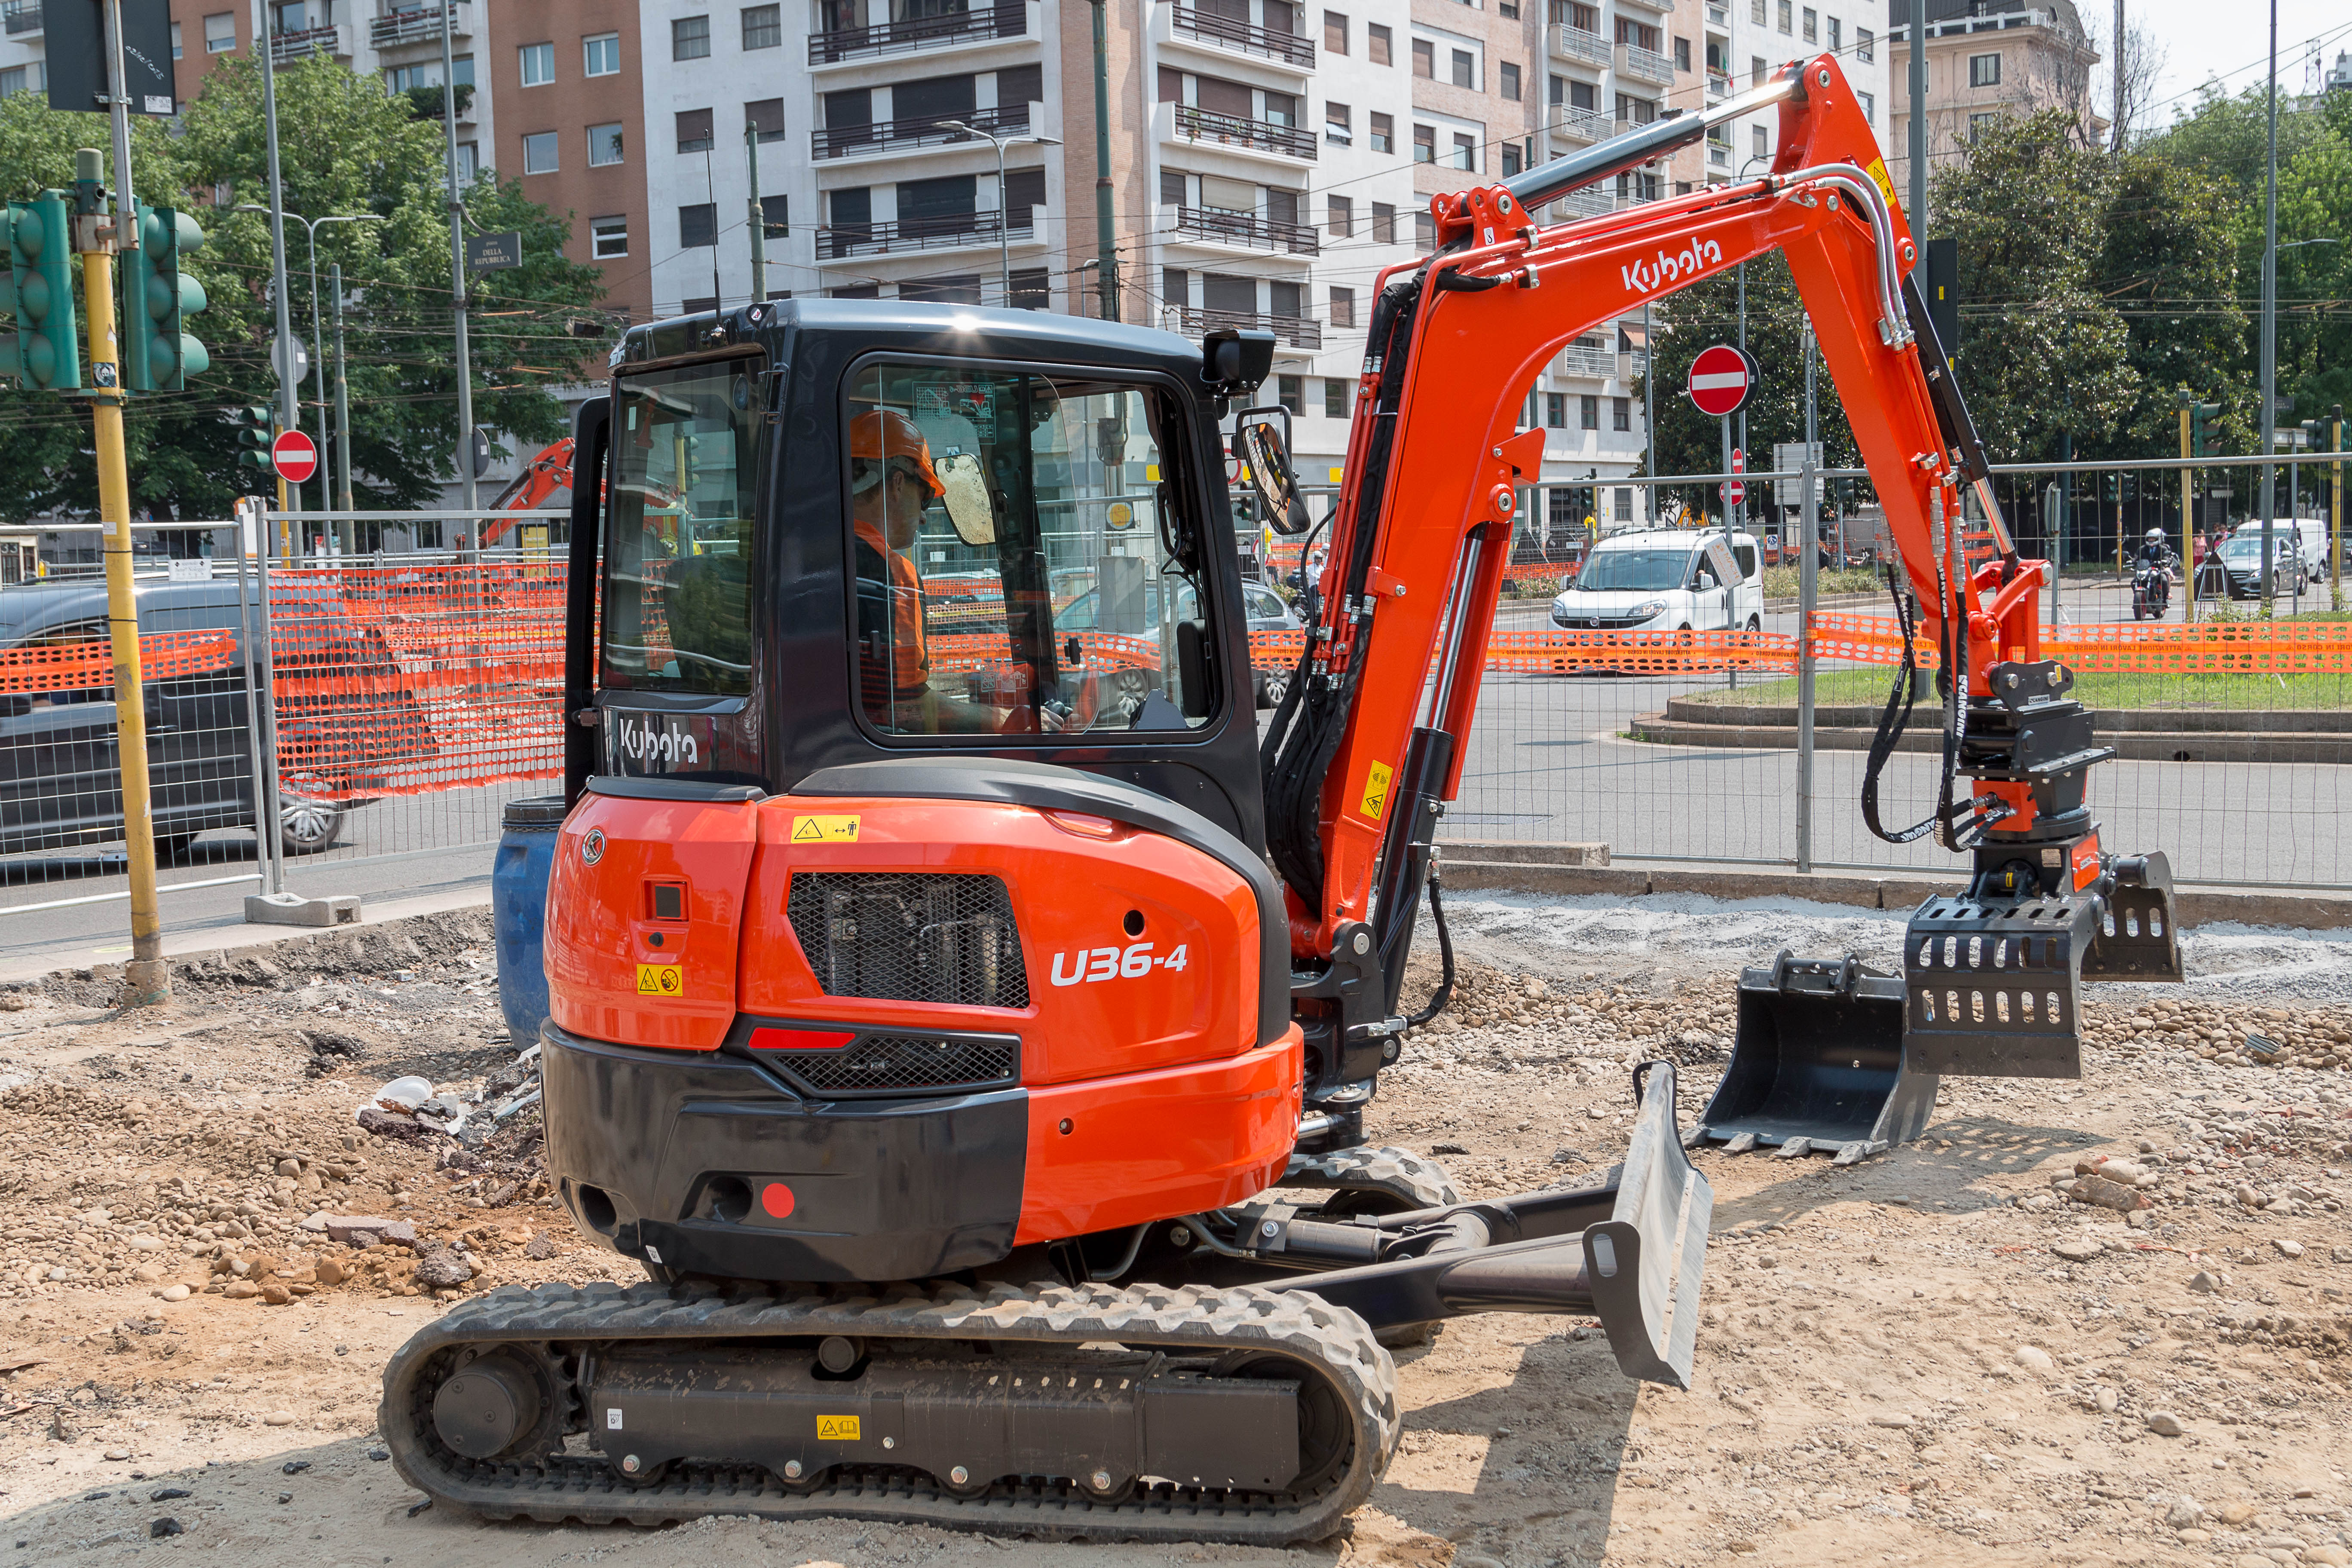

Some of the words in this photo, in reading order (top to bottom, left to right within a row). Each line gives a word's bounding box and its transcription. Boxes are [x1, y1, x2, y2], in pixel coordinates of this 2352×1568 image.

[475, 255, 511, 265] REPUBBLICA
[1621, 236, 1722, 293] Kubota
[1956, 685, 1968, 738] CANGINI
[620, 719, 698, 763] Kubota
[1900, 818, 1936, 842] ANGINI
[1051, 942, 1188, 987] U36-4
